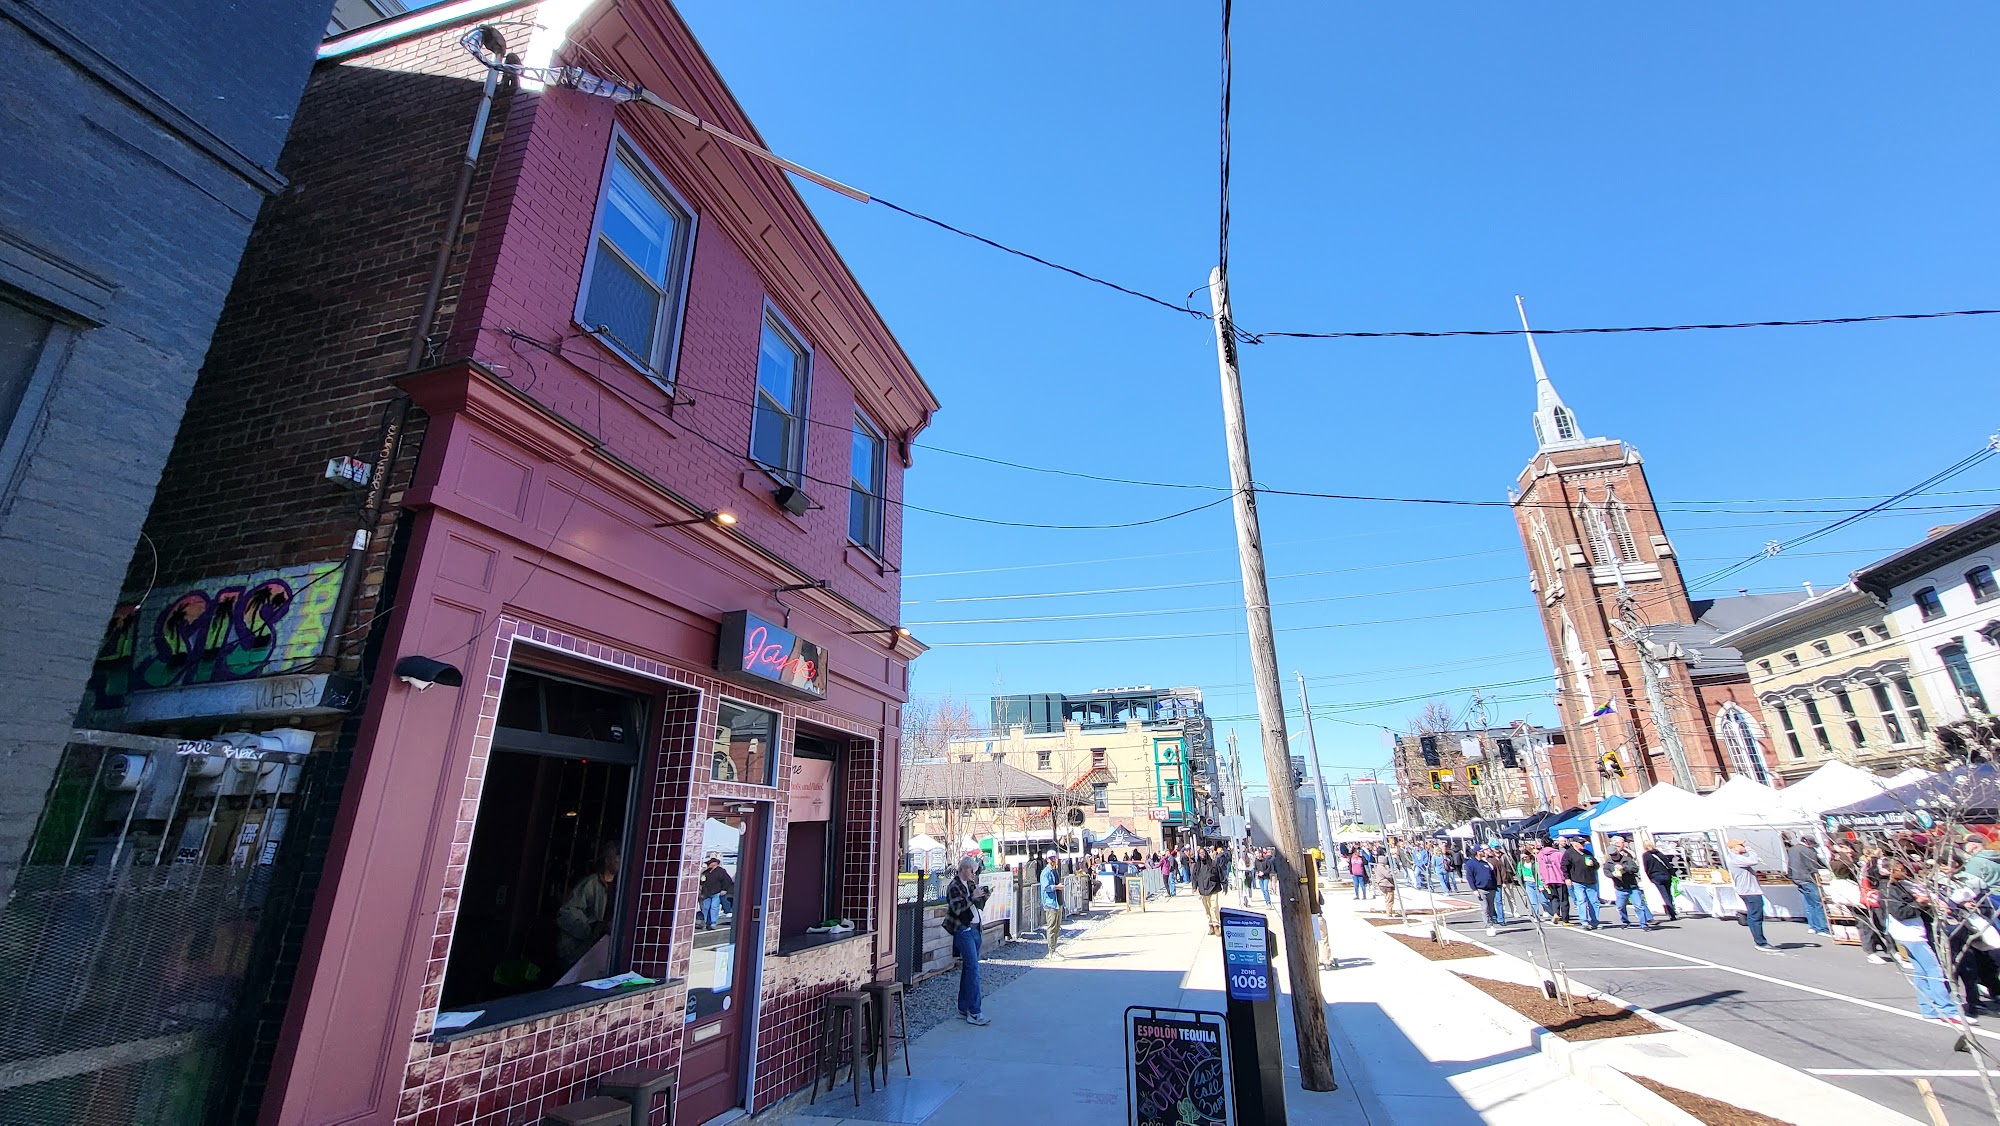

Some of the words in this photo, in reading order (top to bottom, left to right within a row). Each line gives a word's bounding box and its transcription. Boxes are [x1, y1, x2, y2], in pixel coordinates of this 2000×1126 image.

[744, 626, 816, 680] Jane
[1144, 765, 1153, 806] galle
[1231, 975, 1267, 989] 1008
[1178, 1028, 1217, 1043] TEQUILA
[1151, 1060, 1191, 1111] OPEN
